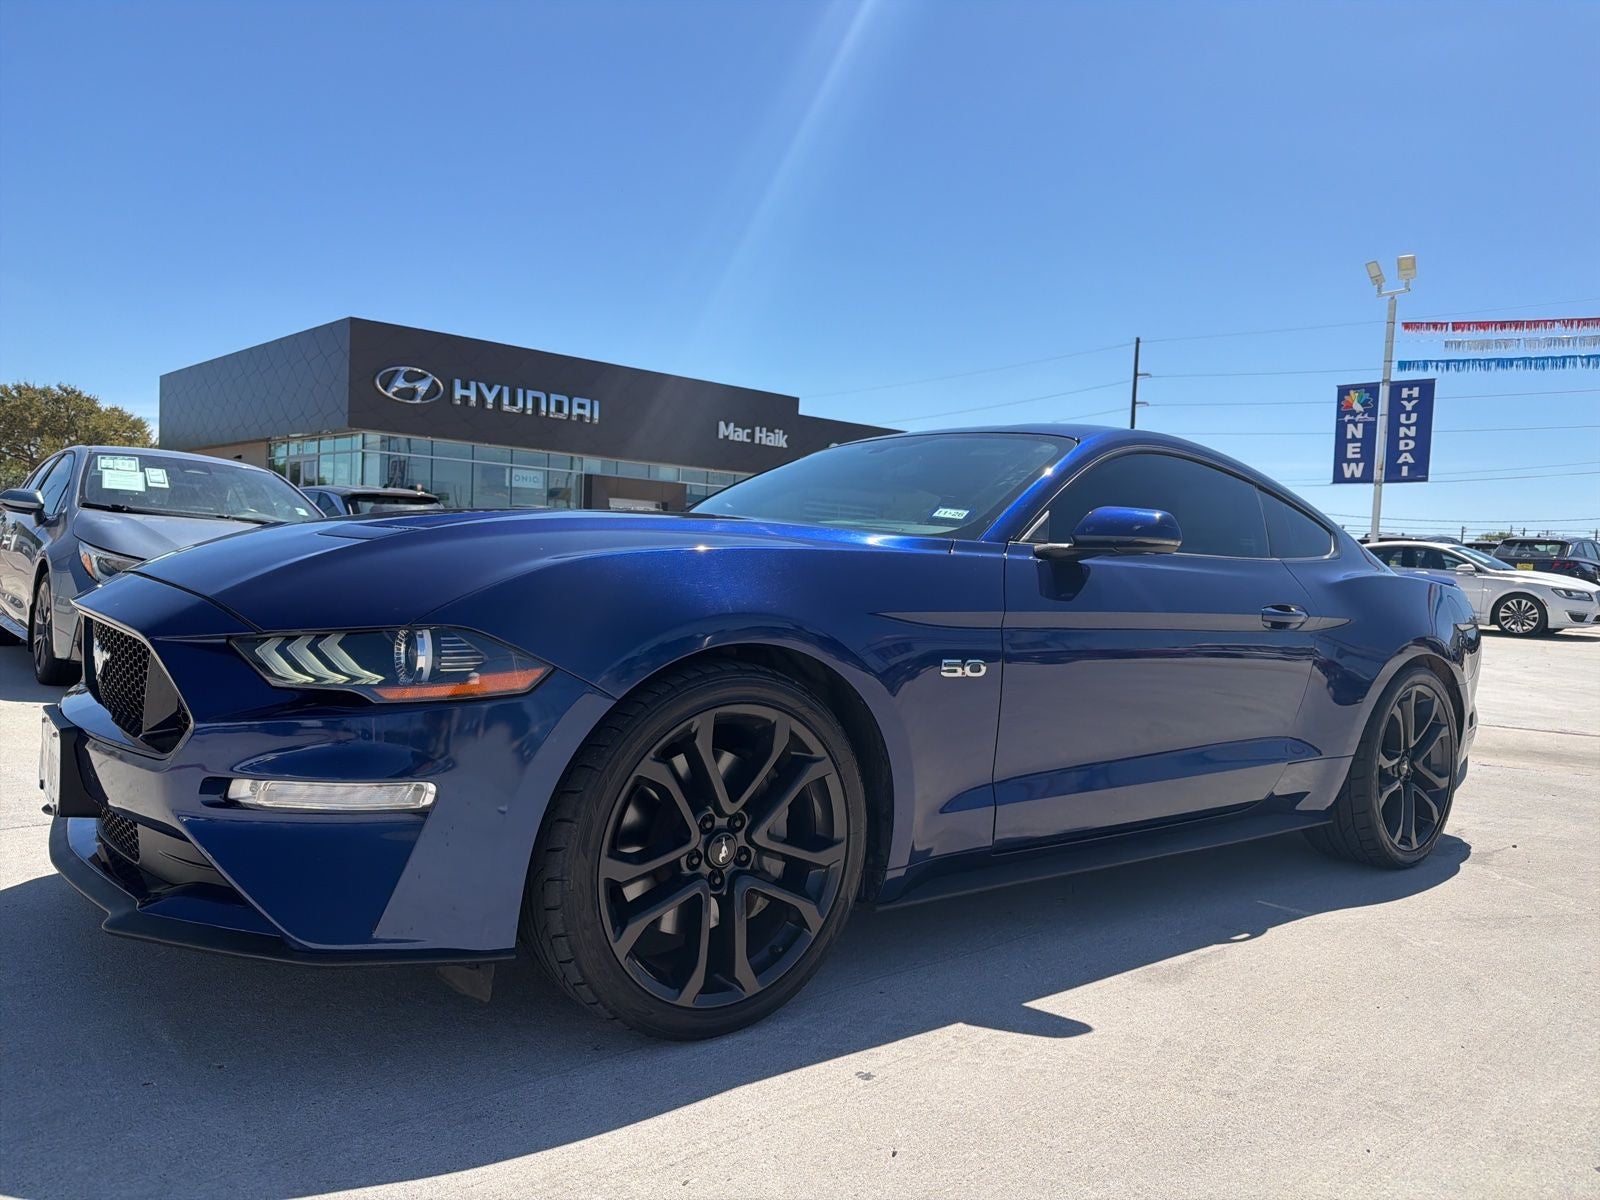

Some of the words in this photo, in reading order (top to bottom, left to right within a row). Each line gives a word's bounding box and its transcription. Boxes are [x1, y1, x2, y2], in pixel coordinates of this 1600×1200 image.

[452, 378, 600, 424] HYUNDAI
[718, 420, 752, 443] Mac
[754, 426, 789, 449] Haik
[1342, 422, 1365, 479] NEW
[1396, 386, 1420, 477] HYUNDAI
[940, 659, 987, 677] 5.0
